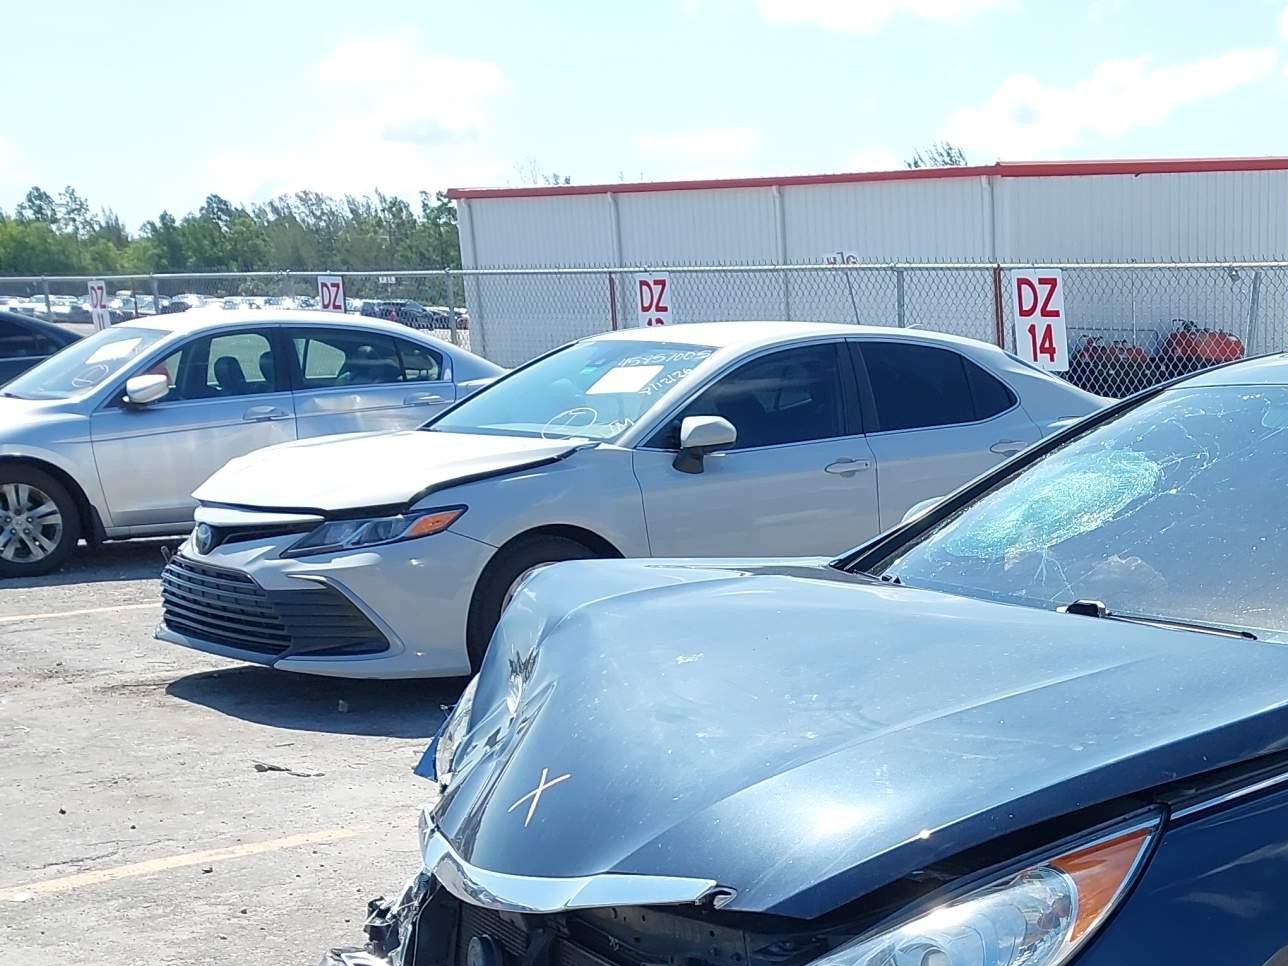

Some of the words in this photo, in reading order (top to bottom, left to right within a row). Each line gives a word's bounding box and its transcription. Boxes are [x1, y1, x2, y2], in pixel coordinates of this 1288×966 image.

[90, 285, 107, 309] DZ
[320, 282, 342, 310] DZ
[639, 279, 668, 312] DZ
[1016, 277, 1060, 317] DZ
[1028, 323, 1056, 362] 14
